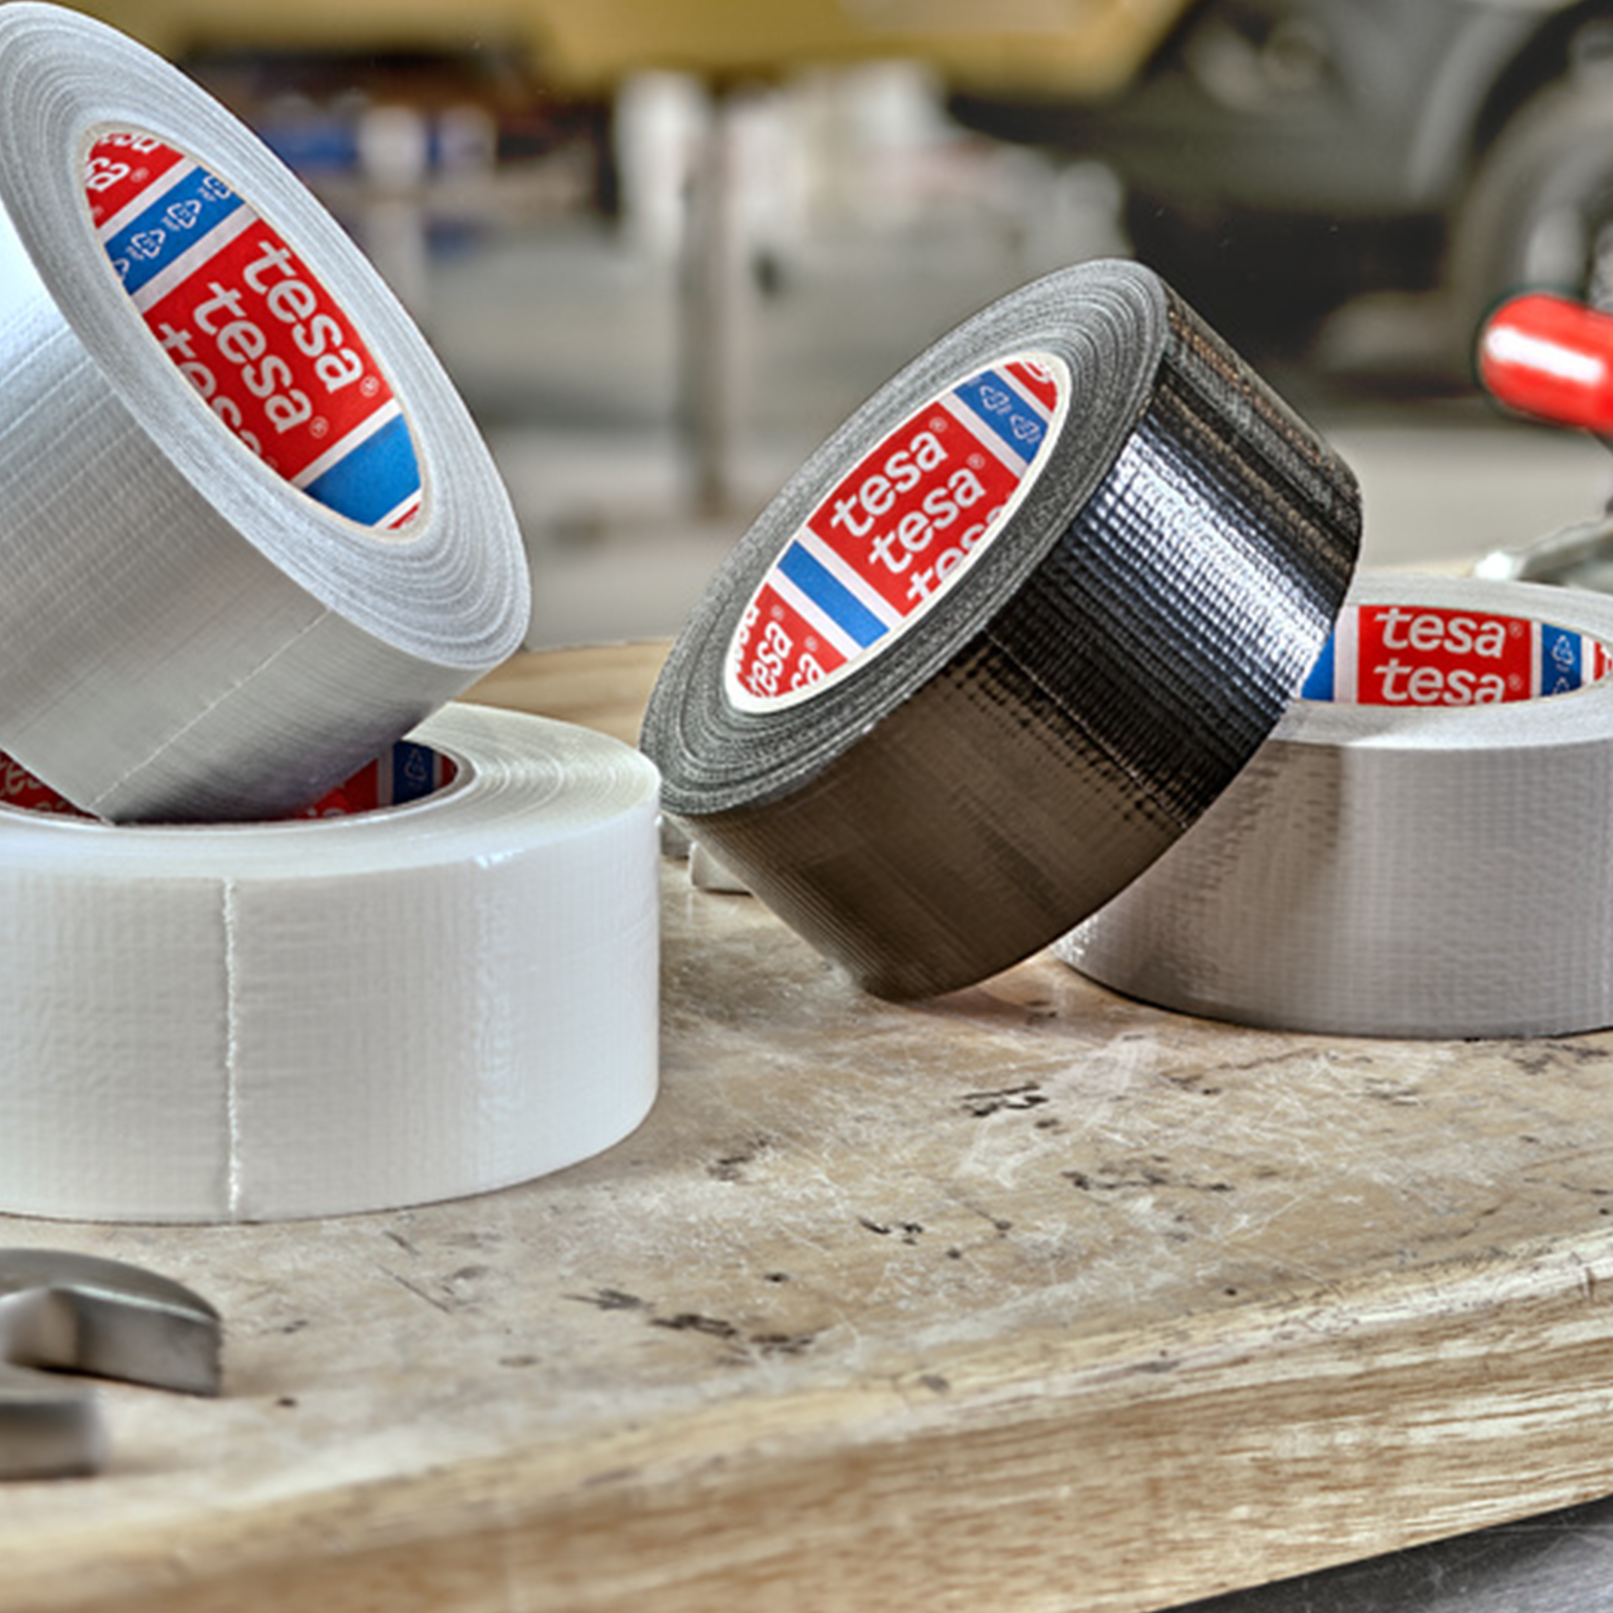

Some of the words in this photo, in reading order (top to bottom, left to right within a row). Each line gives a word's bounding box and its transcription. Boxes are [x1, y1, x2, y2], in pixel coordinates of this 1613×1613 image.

[193, 281, 312, 435] tesa
[242, 240, 363, 394] tesa
[830, 431, 949, 537] tesa
[868, 468, 987, 575] tesa
[1373, 607, 1506, 659] tesa
[1373, 658, 1505, 705] tesa
